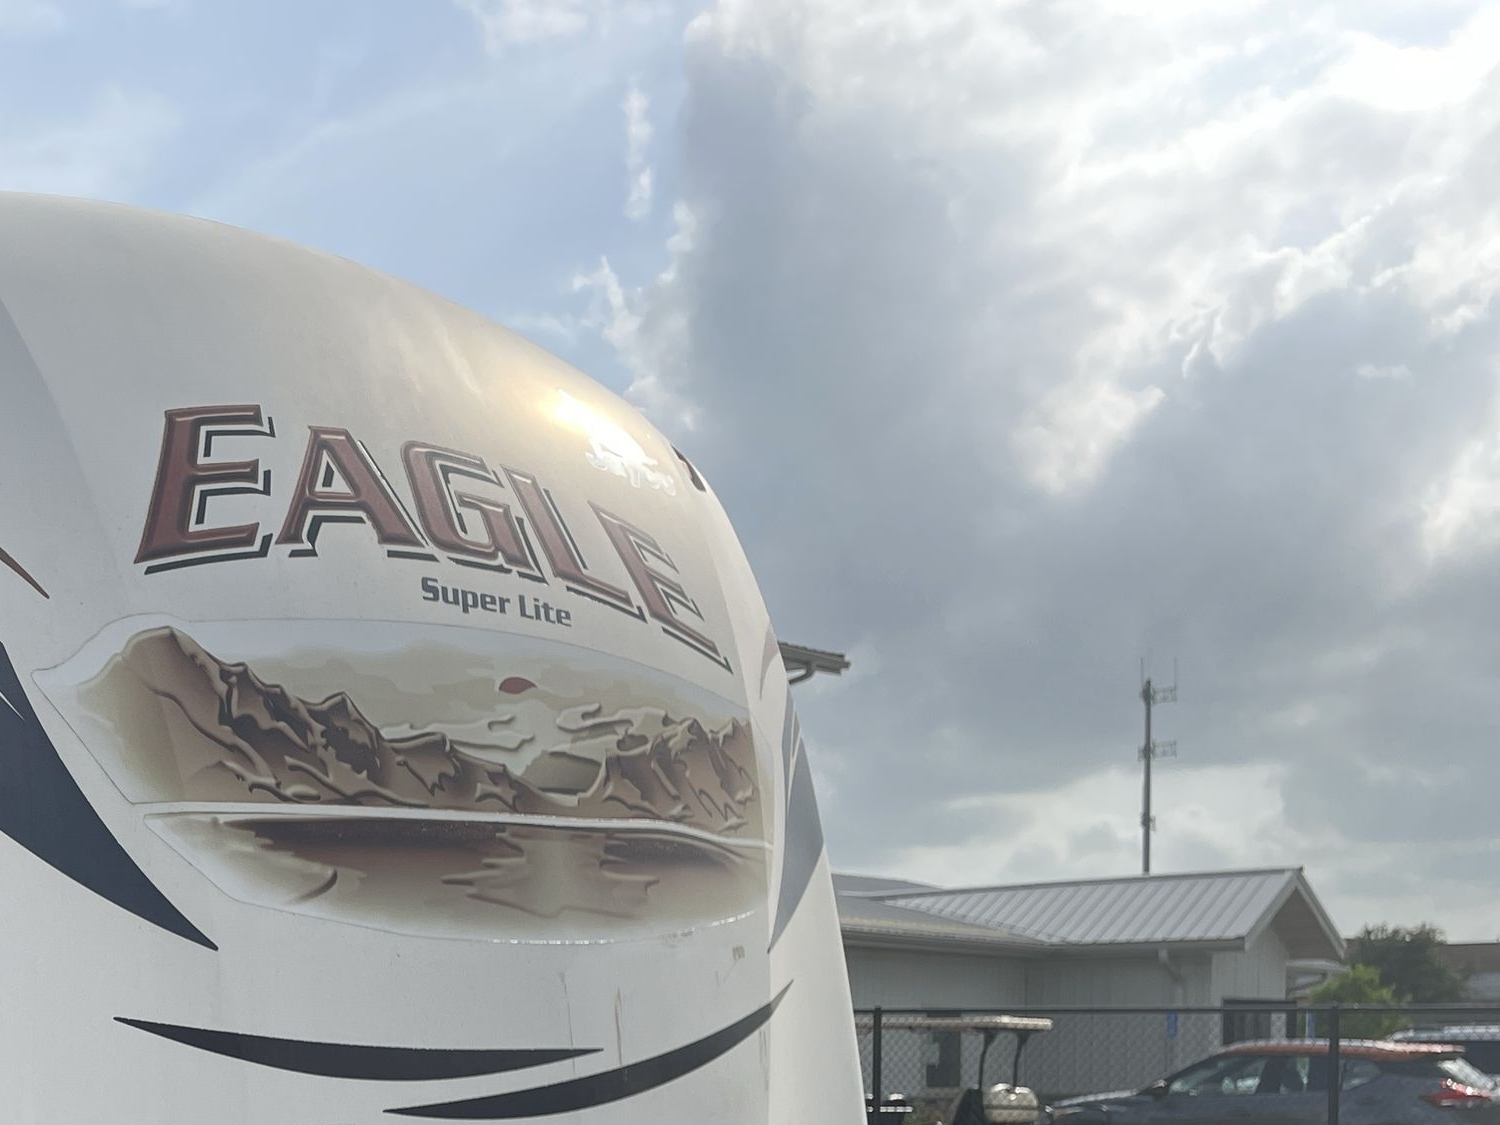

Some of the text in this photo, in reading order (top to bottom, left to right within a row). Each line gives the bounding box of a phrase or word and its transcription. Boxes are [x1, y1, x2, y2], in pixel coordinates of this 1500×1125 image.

[134, 404, 734, 675] EAGLE
[421, 576, 572, 627] Super Lite
